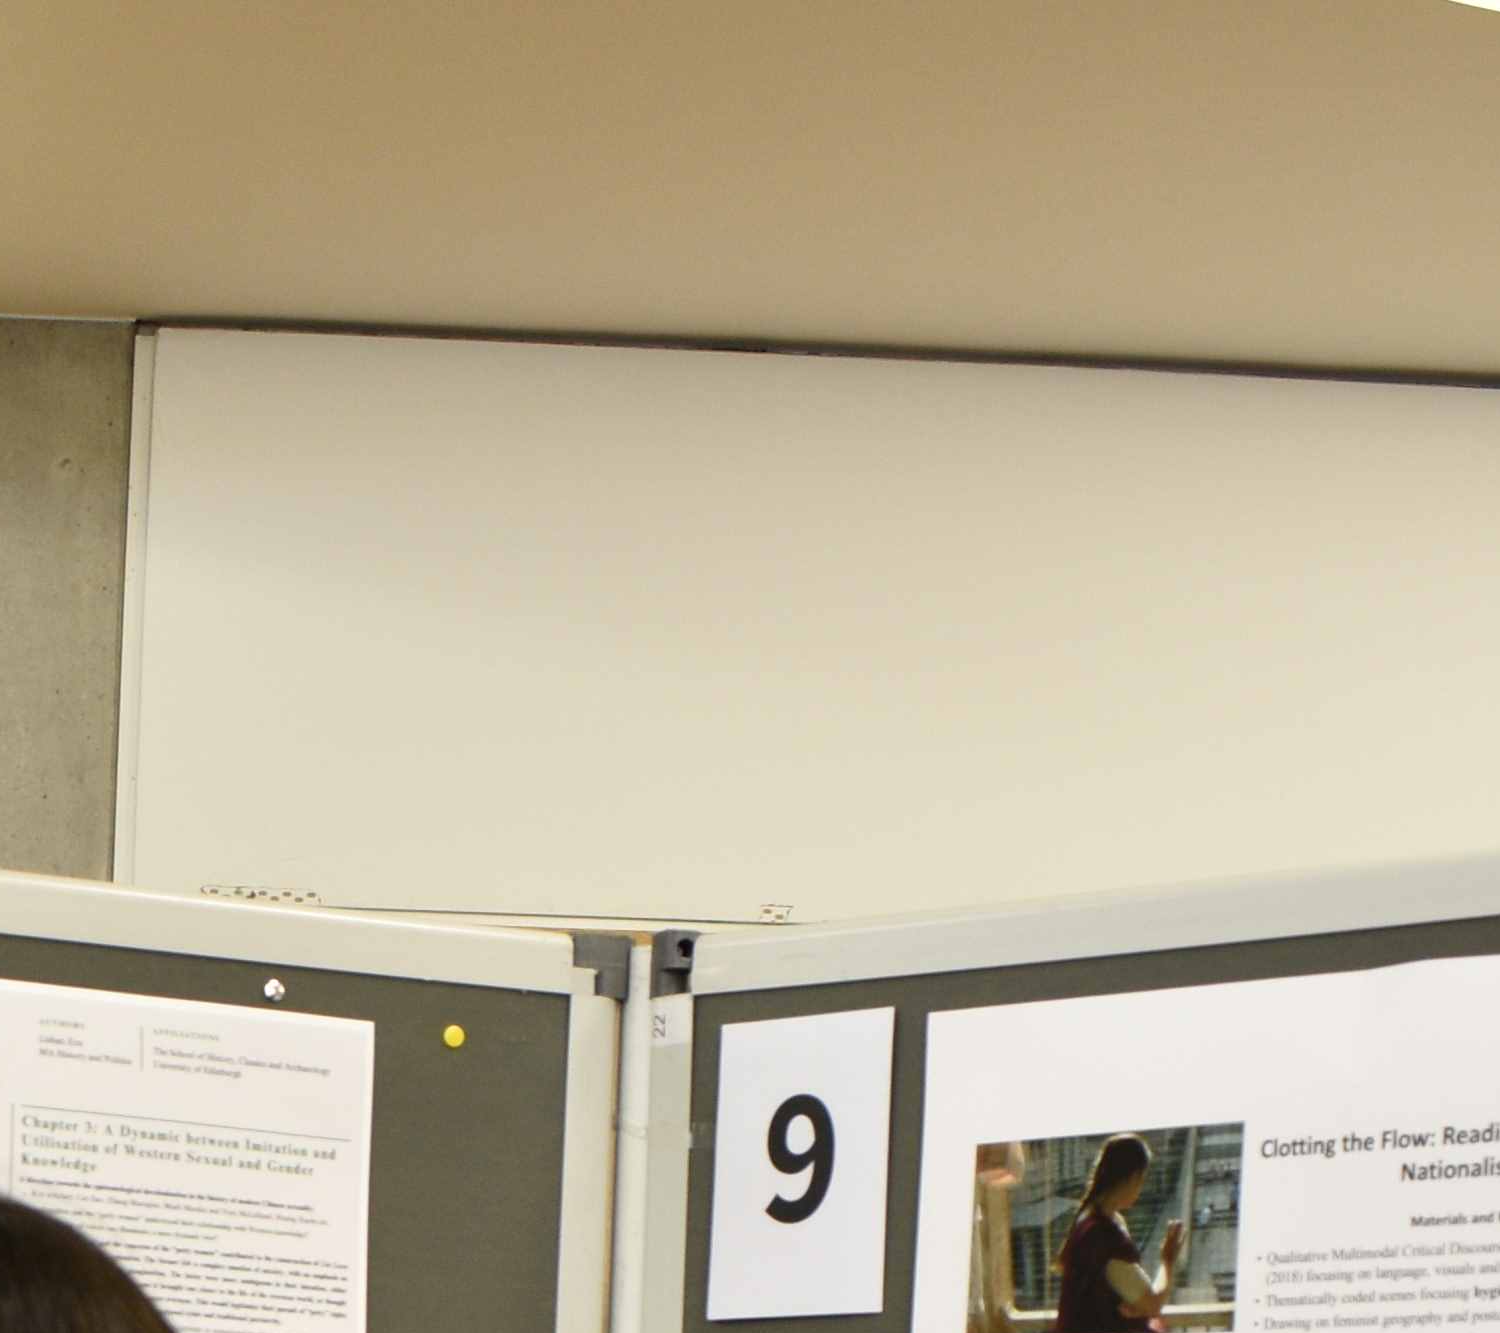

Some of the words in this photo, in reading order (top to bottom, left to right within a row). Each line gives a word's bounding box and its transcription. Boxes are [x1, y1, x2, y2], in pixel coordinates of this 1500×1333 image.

[21, 1115, 77, 1131] Chapter
[105, 1125, 112, 1135] A
[120, 1125, 179, 1141] Dynamic
[186, 1133, 239, 1148] between
[245, 1139, 307, 1155] Imitation
[313, 1149, 335, 1159] and
[1260, 1137, 1336, 1158] Clotting
[1341, 1133, 1374, 1151] the
[1381, 1130, 1435, 1148] Flow:
[21, 1153, 96, 1172] Knowledge
[22, 1134, 98, 1151] Utilisation
[104, 1144, 117, 1154] of
[124, 1145, 180, 1160] Western
[186, 1151, 232, 1166] Sexual
[238, 1160, 260, 1169] and
[267, 1160, 313, 1174] Gender
[765, 1093, 836, 1225] 9
[1410, 1214, 1468, 1225] Materials
[1470, 1213, 1494, 1223] and
[1266, 1252, 1328, 1264] Qualitative
[1402, 1244, 1445, 1255] Critical
[1266, 1293, 1336, 1305] Thematically
[1341, 1291, 1375, 1302] coded
[1379, 1292, 1415, 1300] scenes
[1420, 1289, 1469, 1300] focusing
